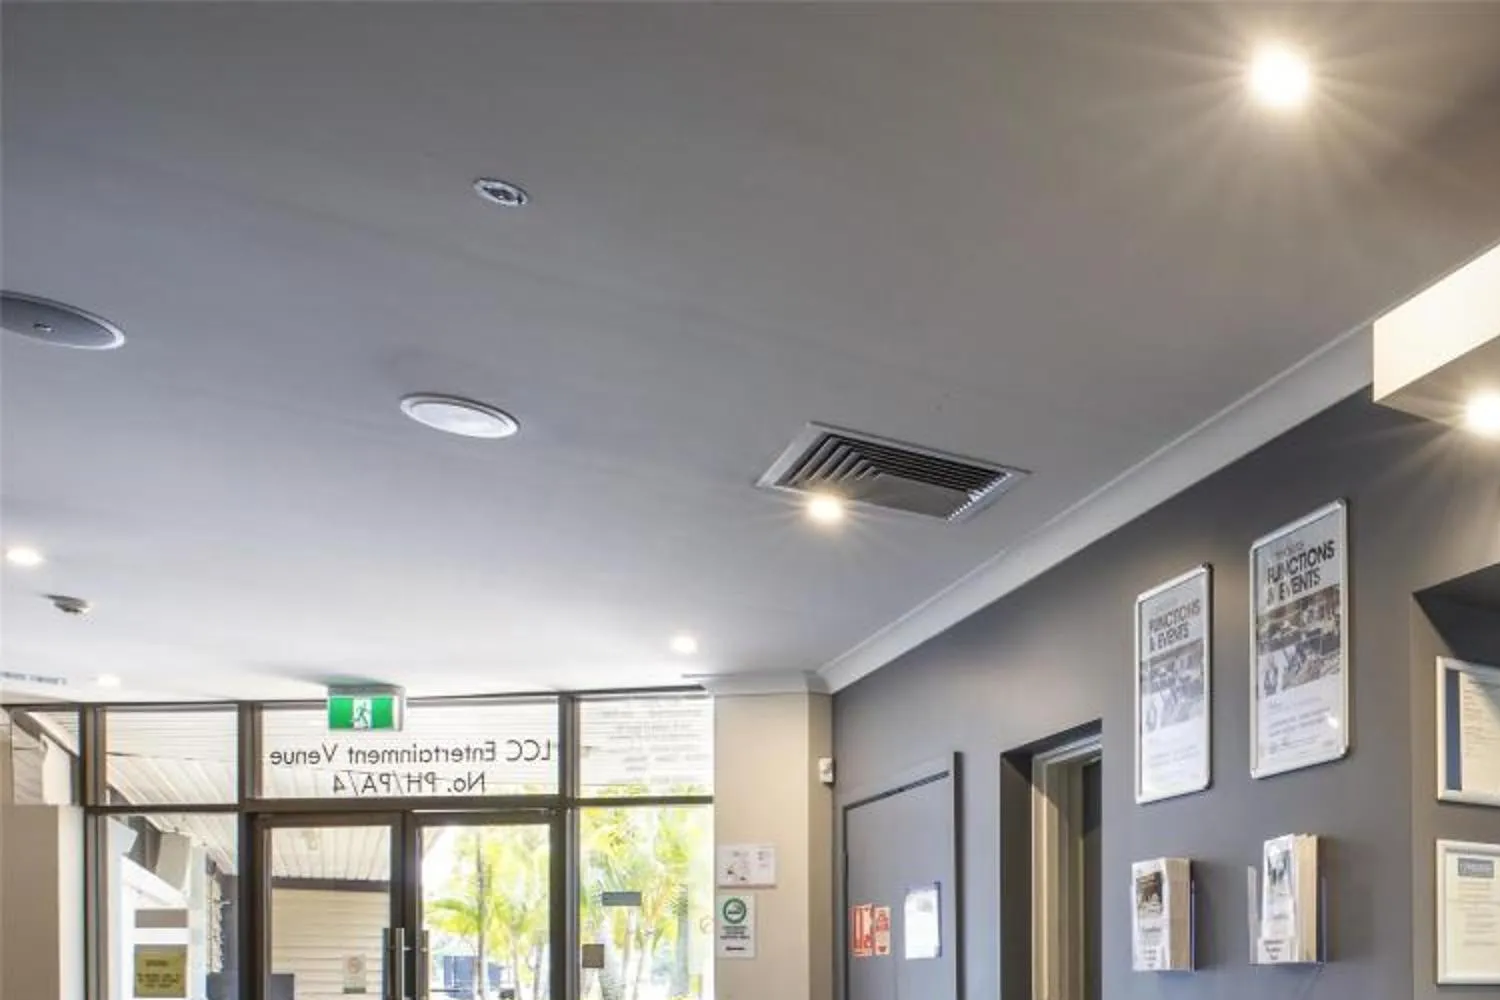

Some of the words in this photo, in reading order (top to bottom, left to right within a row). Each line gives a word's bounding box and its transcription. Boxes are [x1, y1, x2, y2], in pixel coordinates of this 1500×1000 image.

[1266, 539, 1336, 585] FUNCTIONS
[1279, 566, 1322, 601] EVENTS
[1149, 599, 1200, 634] FUNCTIONS
[1157, 621, 1190, 650] EVENTS
